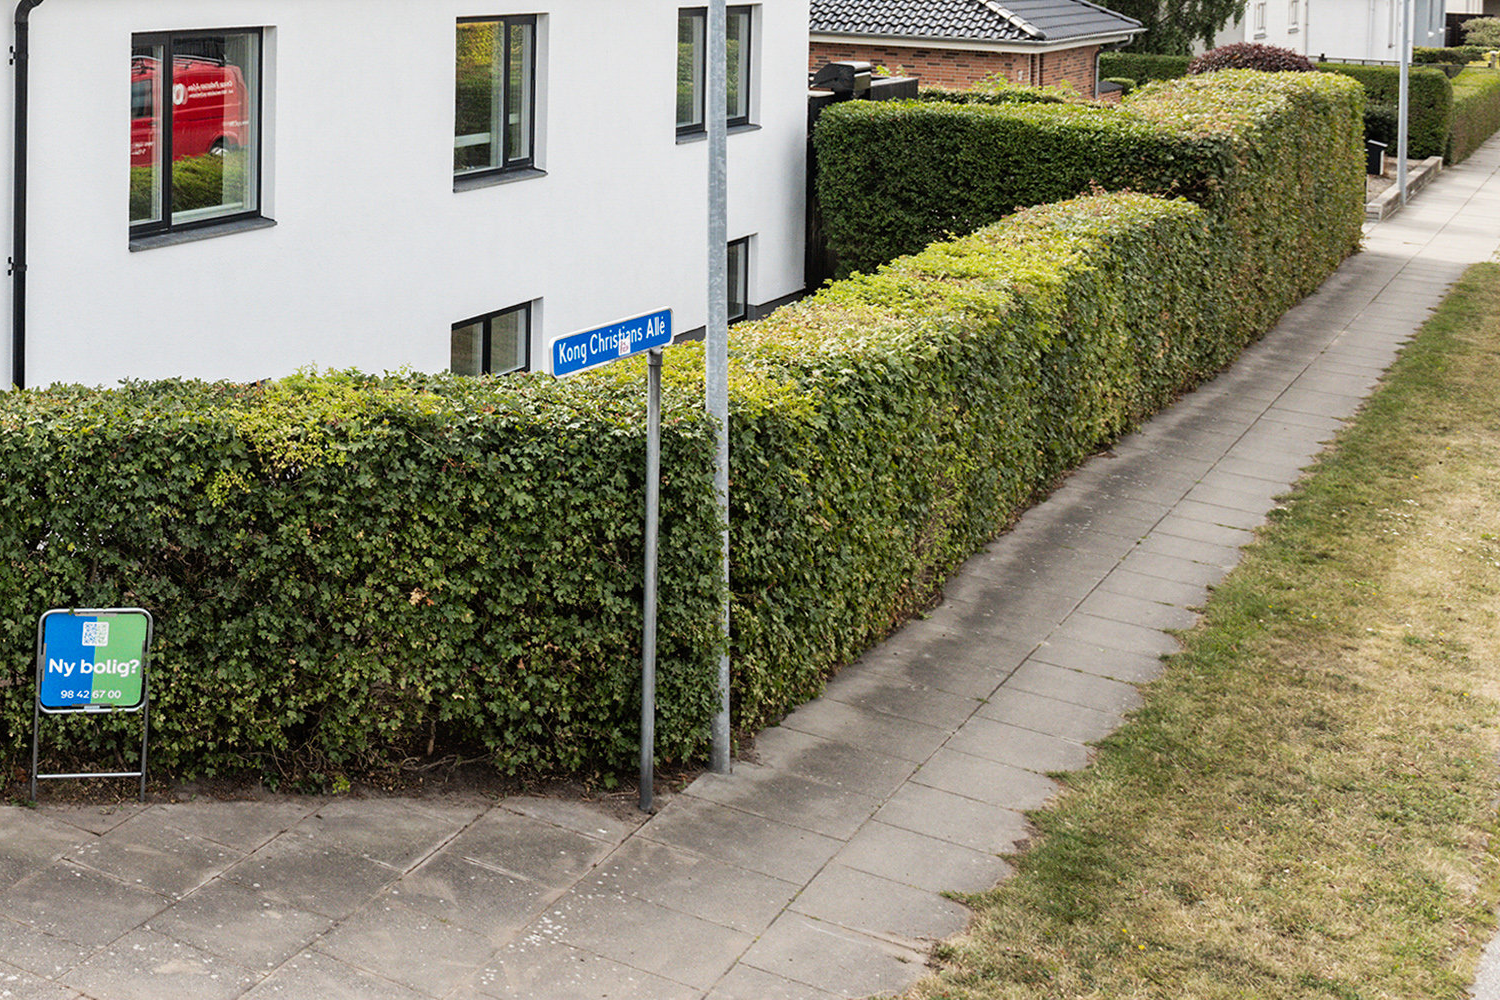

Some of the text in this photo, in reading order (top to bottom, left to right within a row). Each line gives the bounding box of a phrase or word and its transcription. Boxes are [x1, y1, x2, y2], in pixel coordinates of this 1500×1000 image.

[559, 342, 587, 364] Kong
[589, 326, 643, 355] Christians
[48, 658, 140, 677] Ny bolig?
[60, 690, 122, 699] 98 42 67 00
